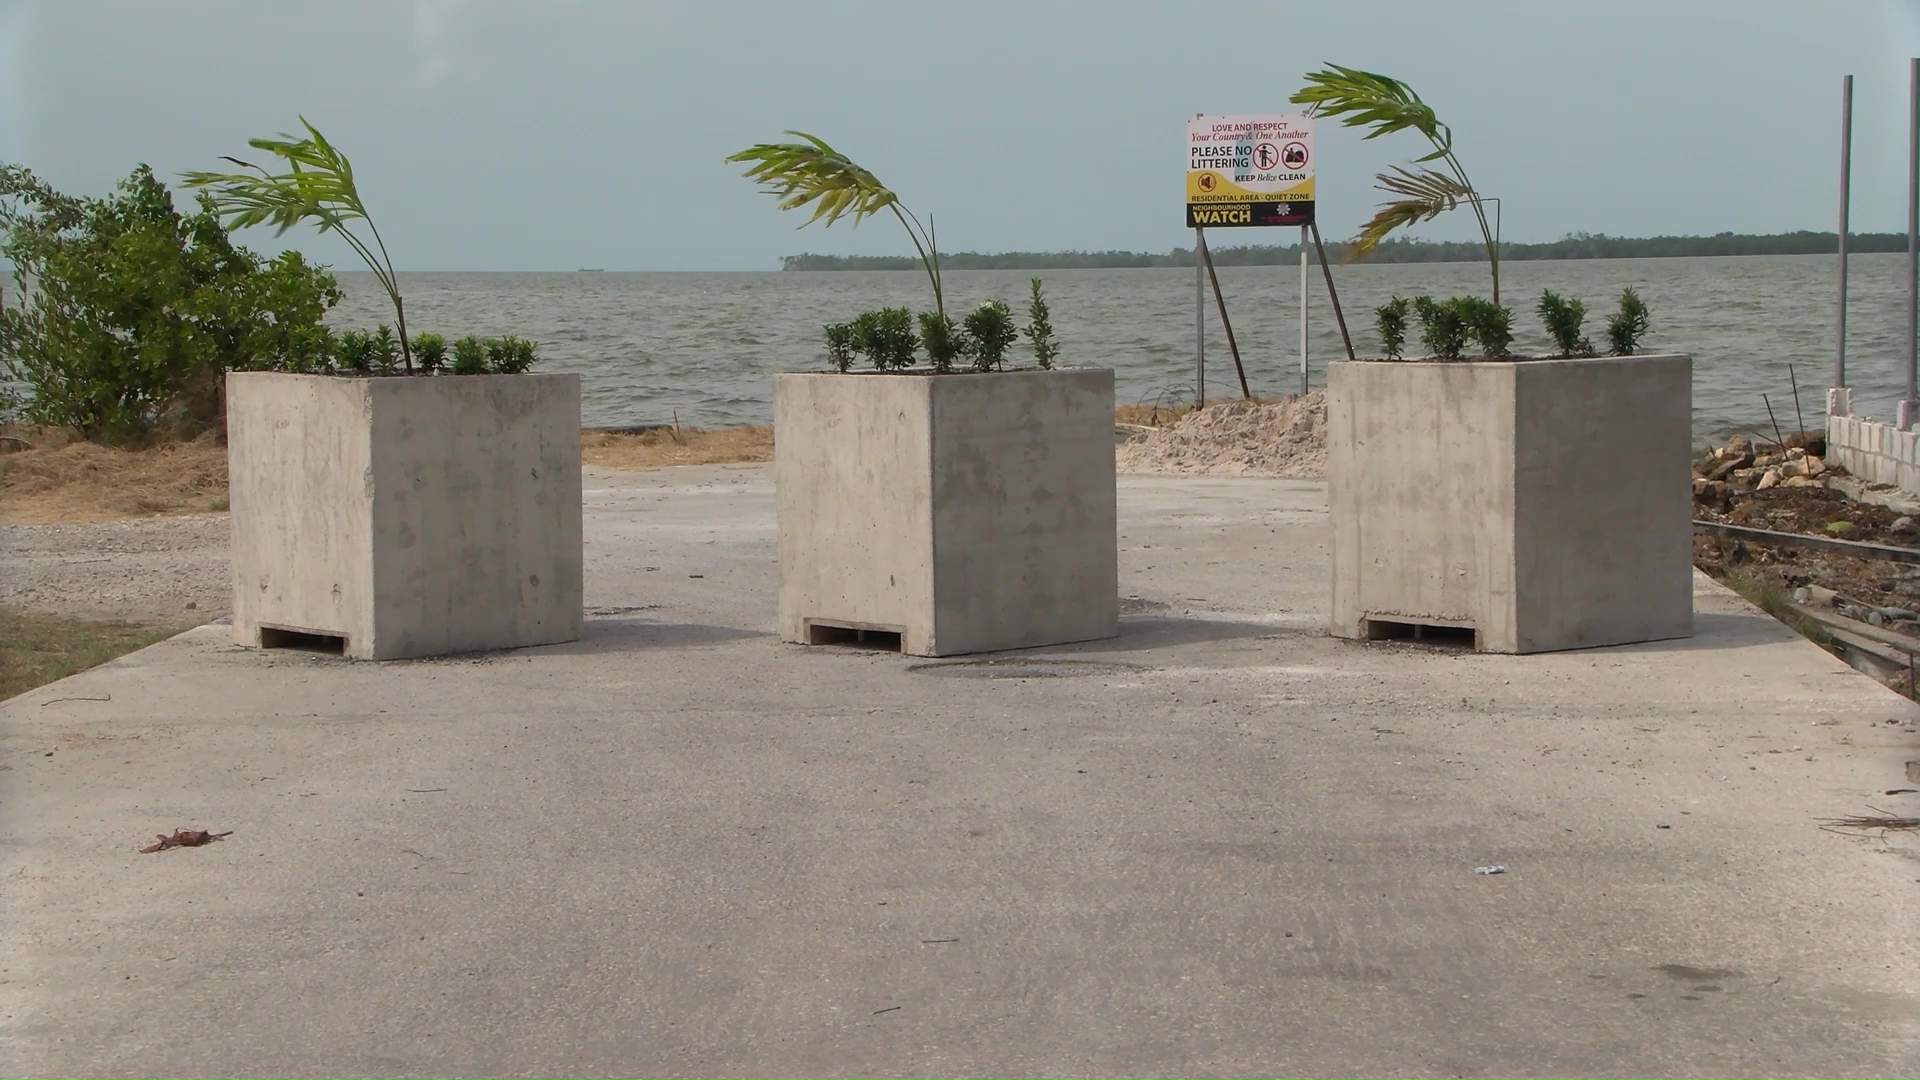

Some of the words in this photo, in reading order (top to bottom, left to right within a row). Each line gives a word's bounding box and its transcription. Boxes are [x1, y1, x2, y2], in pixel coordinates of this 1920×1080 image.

[1212, 124, 1232, 132] LOVE
[1234, 123, 1252, 132] AND
[1254, 122, 1288, 131] RESPECT
[1192, 133, 1210, 142] Your
[1256, 131, 1272, 140] One
[1274, 130, 1308, 140] Another
[1192, 146, 1232, 156] PLEASE
[1236, 145, 1252, 156] NO
[1192, 158, 1249, 168] LITTERING
[1258, 173, 1278, 181] Belize
[1193, 210, 1251, 224] WATCH
